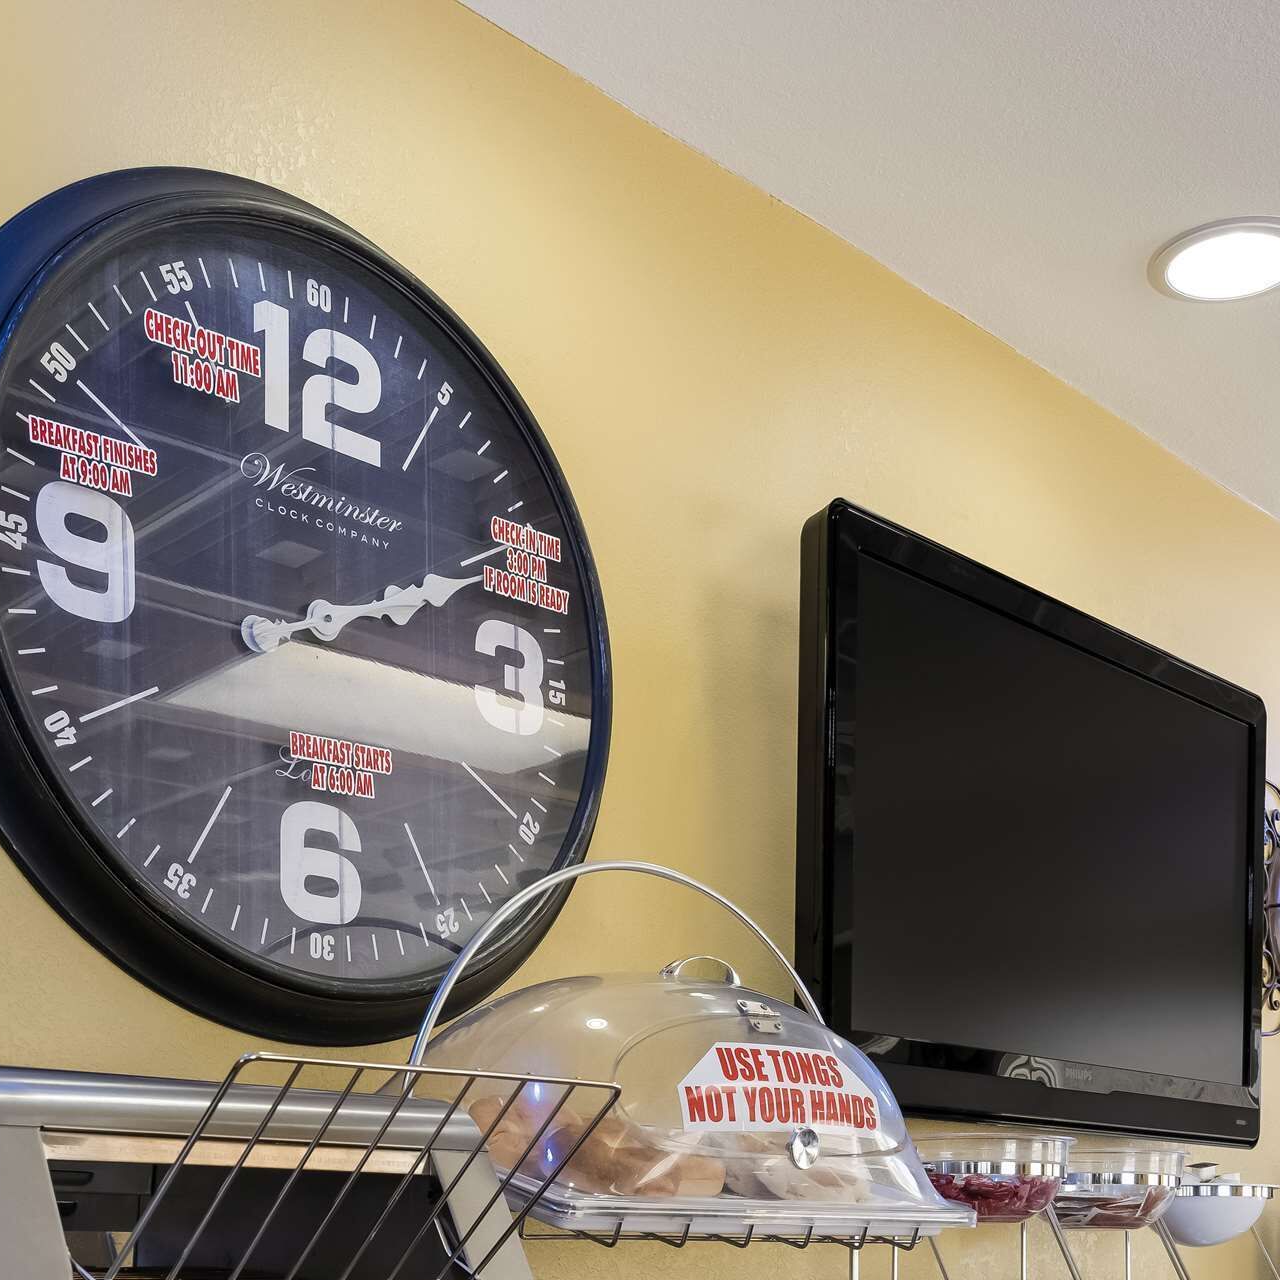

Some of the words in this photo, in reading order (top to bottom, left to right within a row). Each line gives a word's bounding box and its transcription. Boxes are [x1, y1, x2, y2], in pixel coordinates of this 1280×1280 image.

[159, 261, 193, 294] 55
[306, 278, 332, 313] 60
[40, 342, 77, 382] 50
[144, 308, 224, 365] CHECK-OUT
[227, 337, 261, 377] TIME
[172, 352, 213, 393] 11:00
[215, 366, 240, 403] AM
[254, 300, 381, 468] 12
[437, 381, 454, 406] 5
[29, 415, 100, 459] BREAKFAST
[102, 436, 157, 476] FINISHES
[61, 453, 77, 482] AT
[79, 458, 108, 490] 9:00
[110, 466, 132, 497] AM
[240, 452, 403, 532] Westminster
[0, 510, 28, 550] 45
[255, 498, 309, 524] CLOCK
[315, 518, 390, 550] COMPANY
[491, 516, 537, 554] CHECK-IN
[538, 532, 561, 562] TIME
[36, 481, 136, 623] 9
[507, 547, 529, 578] 3:00
[531, 555, 547, 583] PM
[484, 565, 494, 592] IF
[496, 569, 527, 602] ROOM
[528, 579, 537, 605] IS
[539, 583, 569, 615] READY
[475, 619, 544, 736] 3
[548, 679, 566, 706] 15
[44, 710, 77, 747] 40
[290, 731, 352, 767] BREAKFAST
[354, 743, 392, 775] STARTS
[312, 763, 326, 790] AT
[328, 766, 354, 795] 6:00
[355, 771, 375, 799] AM
[518, 811, 540, 846] 20
[163, 862, 197, 899] 35
[280, 801, 362, 925] 6
[435, 907, 459, 939] 25
[310, 932, 335, 961] 30
[715, 1047, 769, 1083] USE
[766, 1050, 844, 1089] TONGS
[684, 1085, 737, 1123] NOT
[742, 1085, 806, 1124] YOUR
[809, 1089, 877, 1131] HANDS
